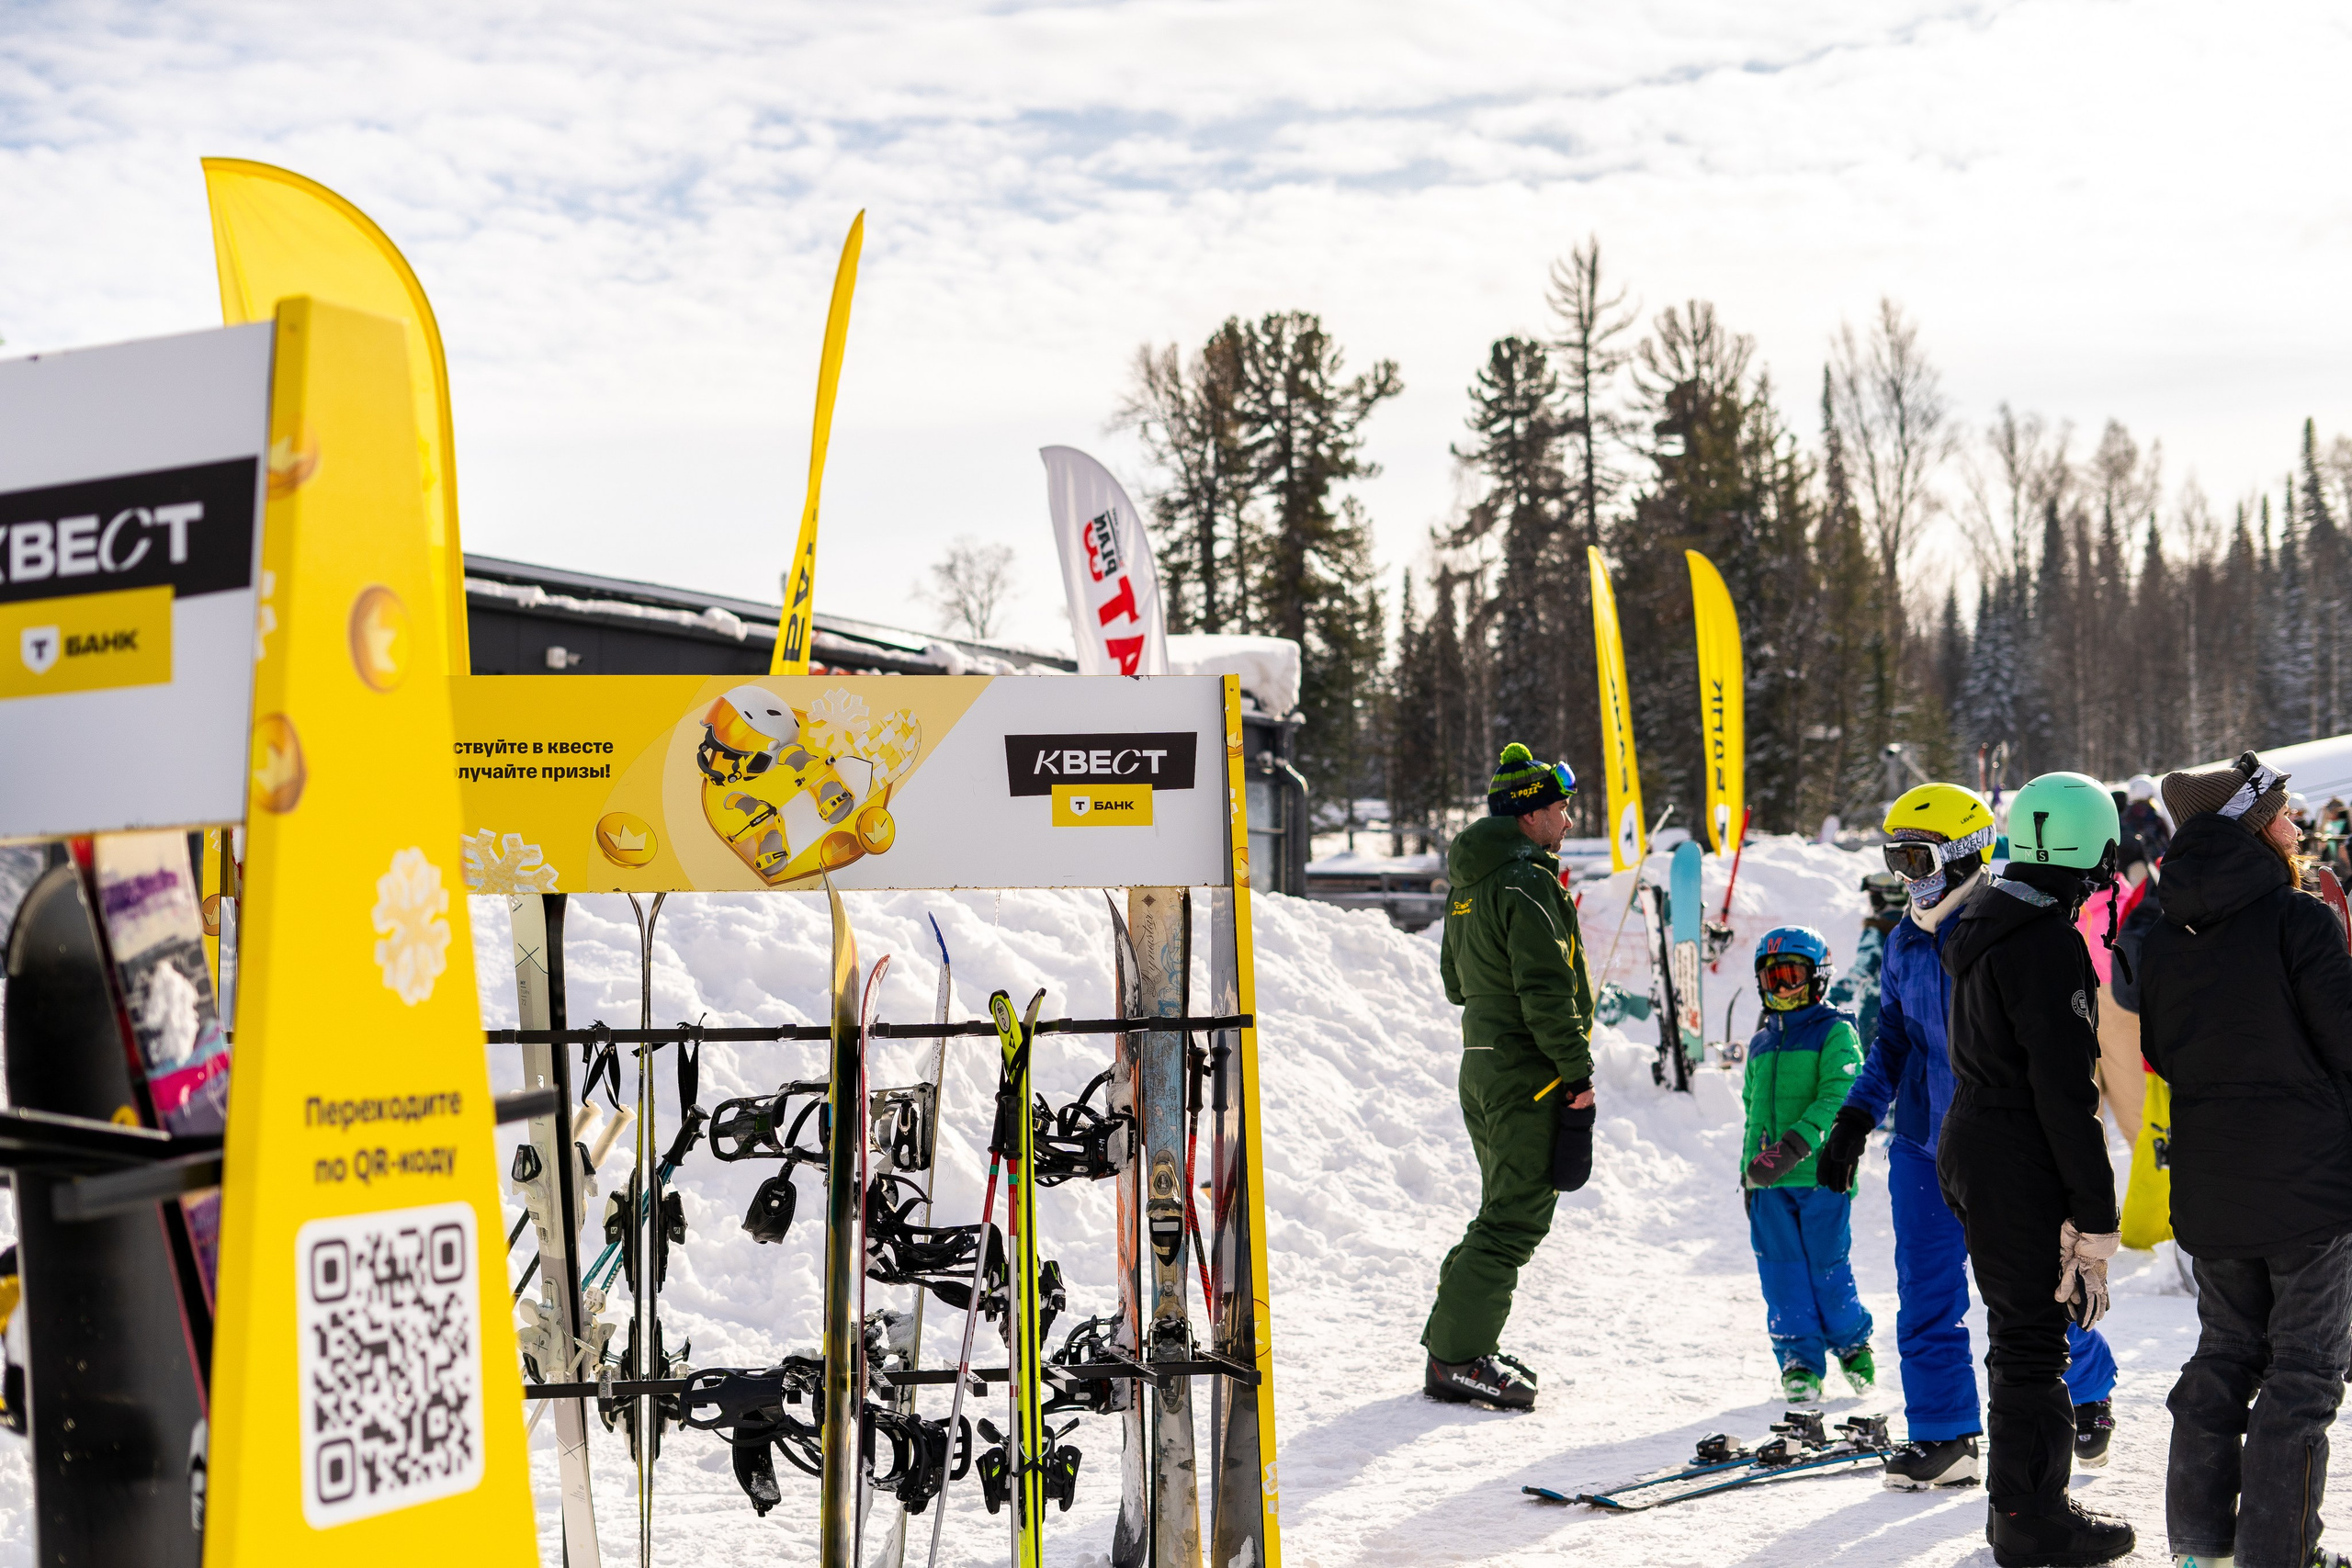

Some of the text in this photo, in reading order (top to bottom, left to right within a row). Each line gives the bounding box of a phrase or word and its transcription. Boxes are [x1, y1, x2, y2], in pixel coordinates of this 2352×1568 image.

[64, 629, 139, 657] БАНК
[453, 739, 614, 758] ствуйте в квесте
[1033, 749, 1168, 775] КВЕСТ
[454, 763, 611, 783] лучайте призы!
[1075, 801, 1135, 811] Т БАНК
[1960, 814, 1975, 824] LEVEL
[1950, 837, 1982, 854] LEVEL
[305, 1090, 463, 1133] Переходите
[314, 1144, 458, 1187] по QR-коду
[1453, 1373, 1500, 1396] HEAD
